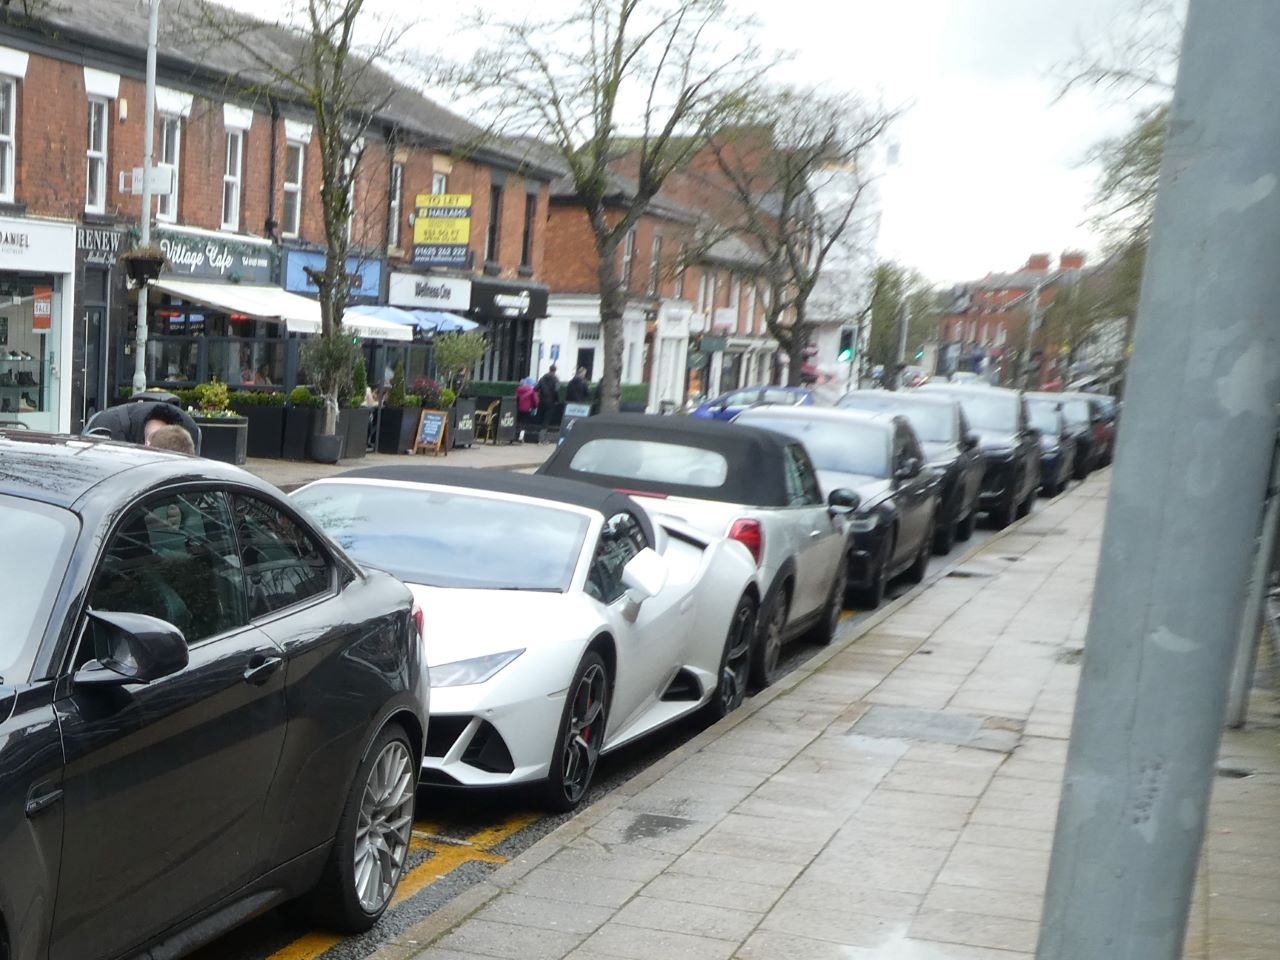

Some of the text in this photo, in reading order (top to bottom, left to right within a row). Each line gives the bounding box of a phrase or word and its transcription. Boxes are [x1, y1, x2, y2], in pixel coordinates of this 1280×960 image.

[428, 208, 467, 217] HALLAMS
[77, 228, 120, 251] RENEW
[160, 239, 204, 273] Village
[35, 303, 50, 313] SALE
